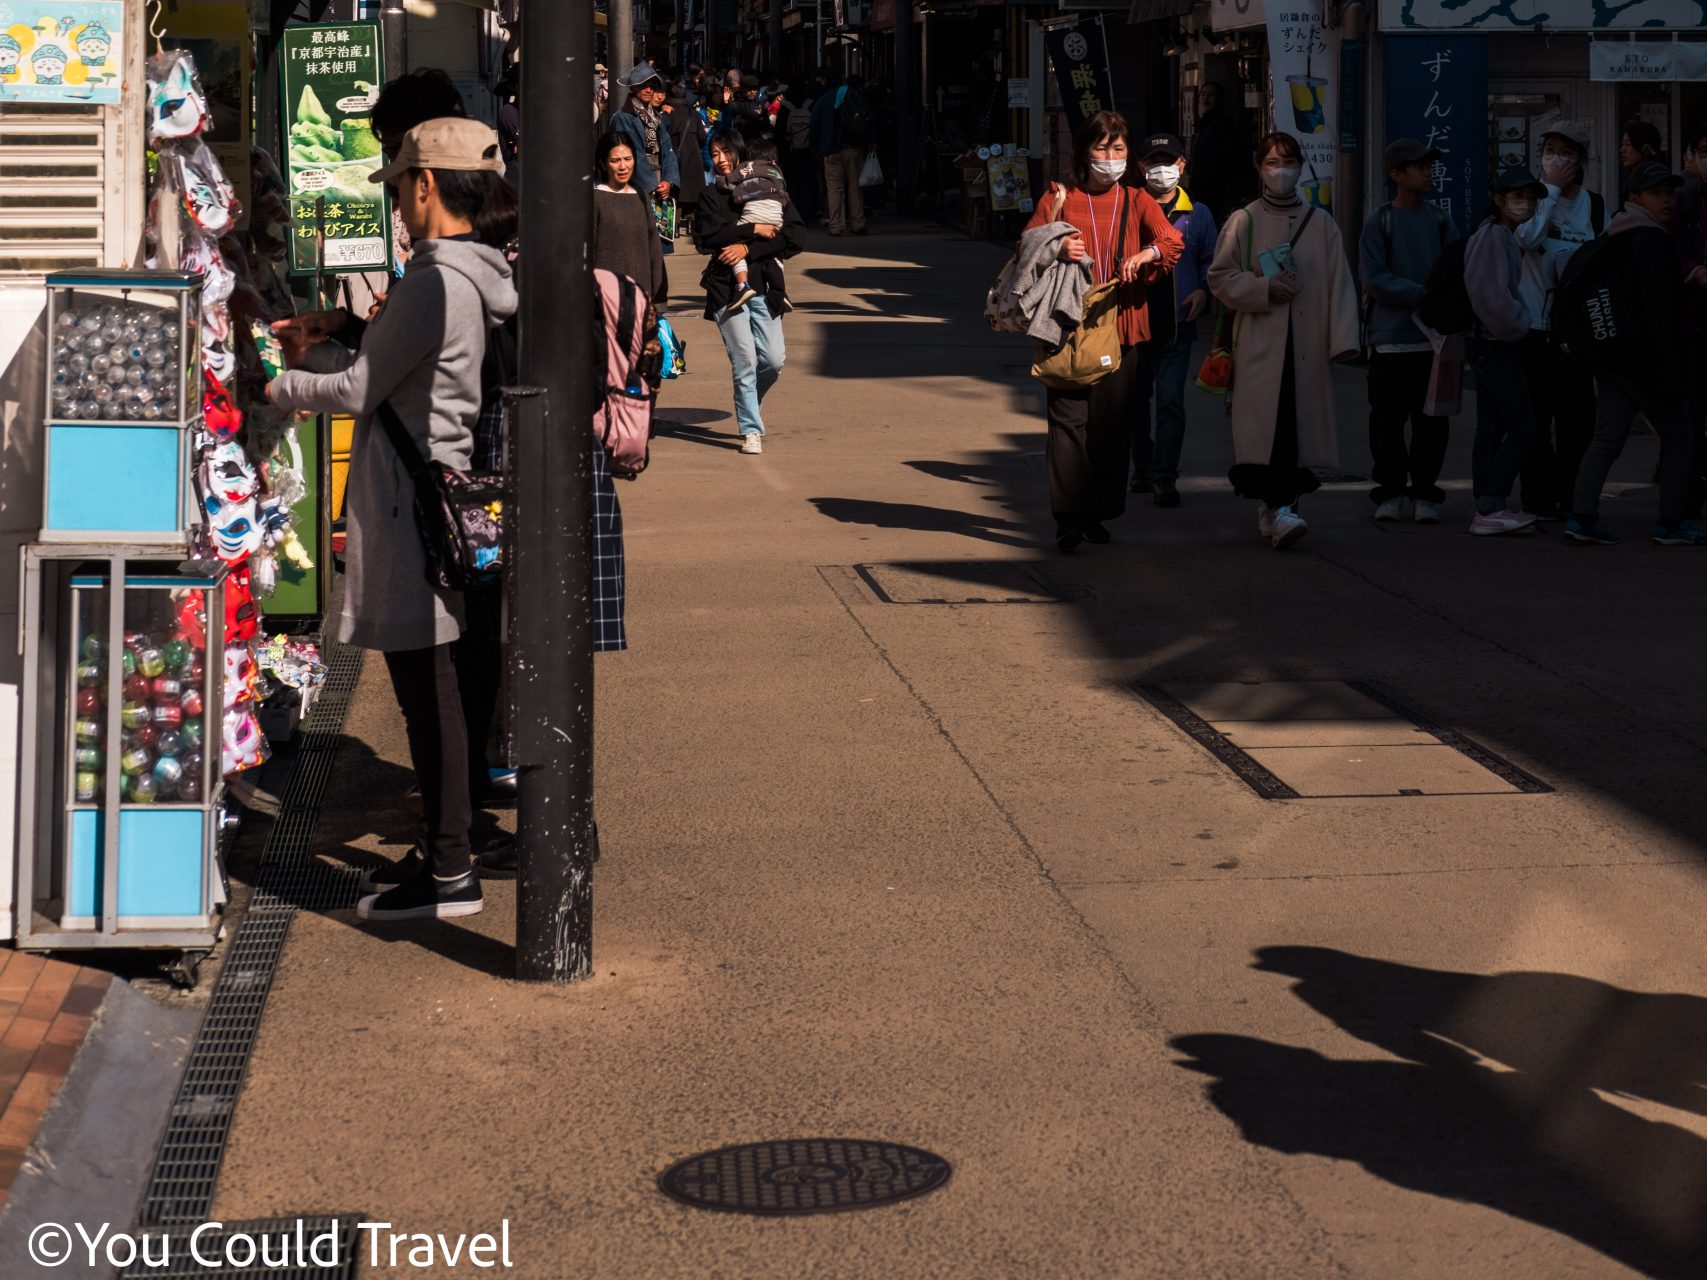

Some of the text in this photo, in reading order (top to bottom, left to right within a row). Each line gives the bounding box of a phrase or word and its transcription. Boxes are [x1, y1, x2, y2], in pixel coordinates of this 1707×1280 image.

[310, 30, 350, 44] 最高峰
[1281, 25, 1322, 41] ずんだ
[291, 44, 371, 61] 『京都宇治産』
[1283, 41, 1328, 54] シェイク
[1625, 54, 1649, 64] KYO
[305, 60, 357, 76] 抹茶使用
[1609, 65, 1668, 74] KAMAKURA
[1463, 157, 1472, 184] SOY
[338, 242, 384, 262] ¥670
